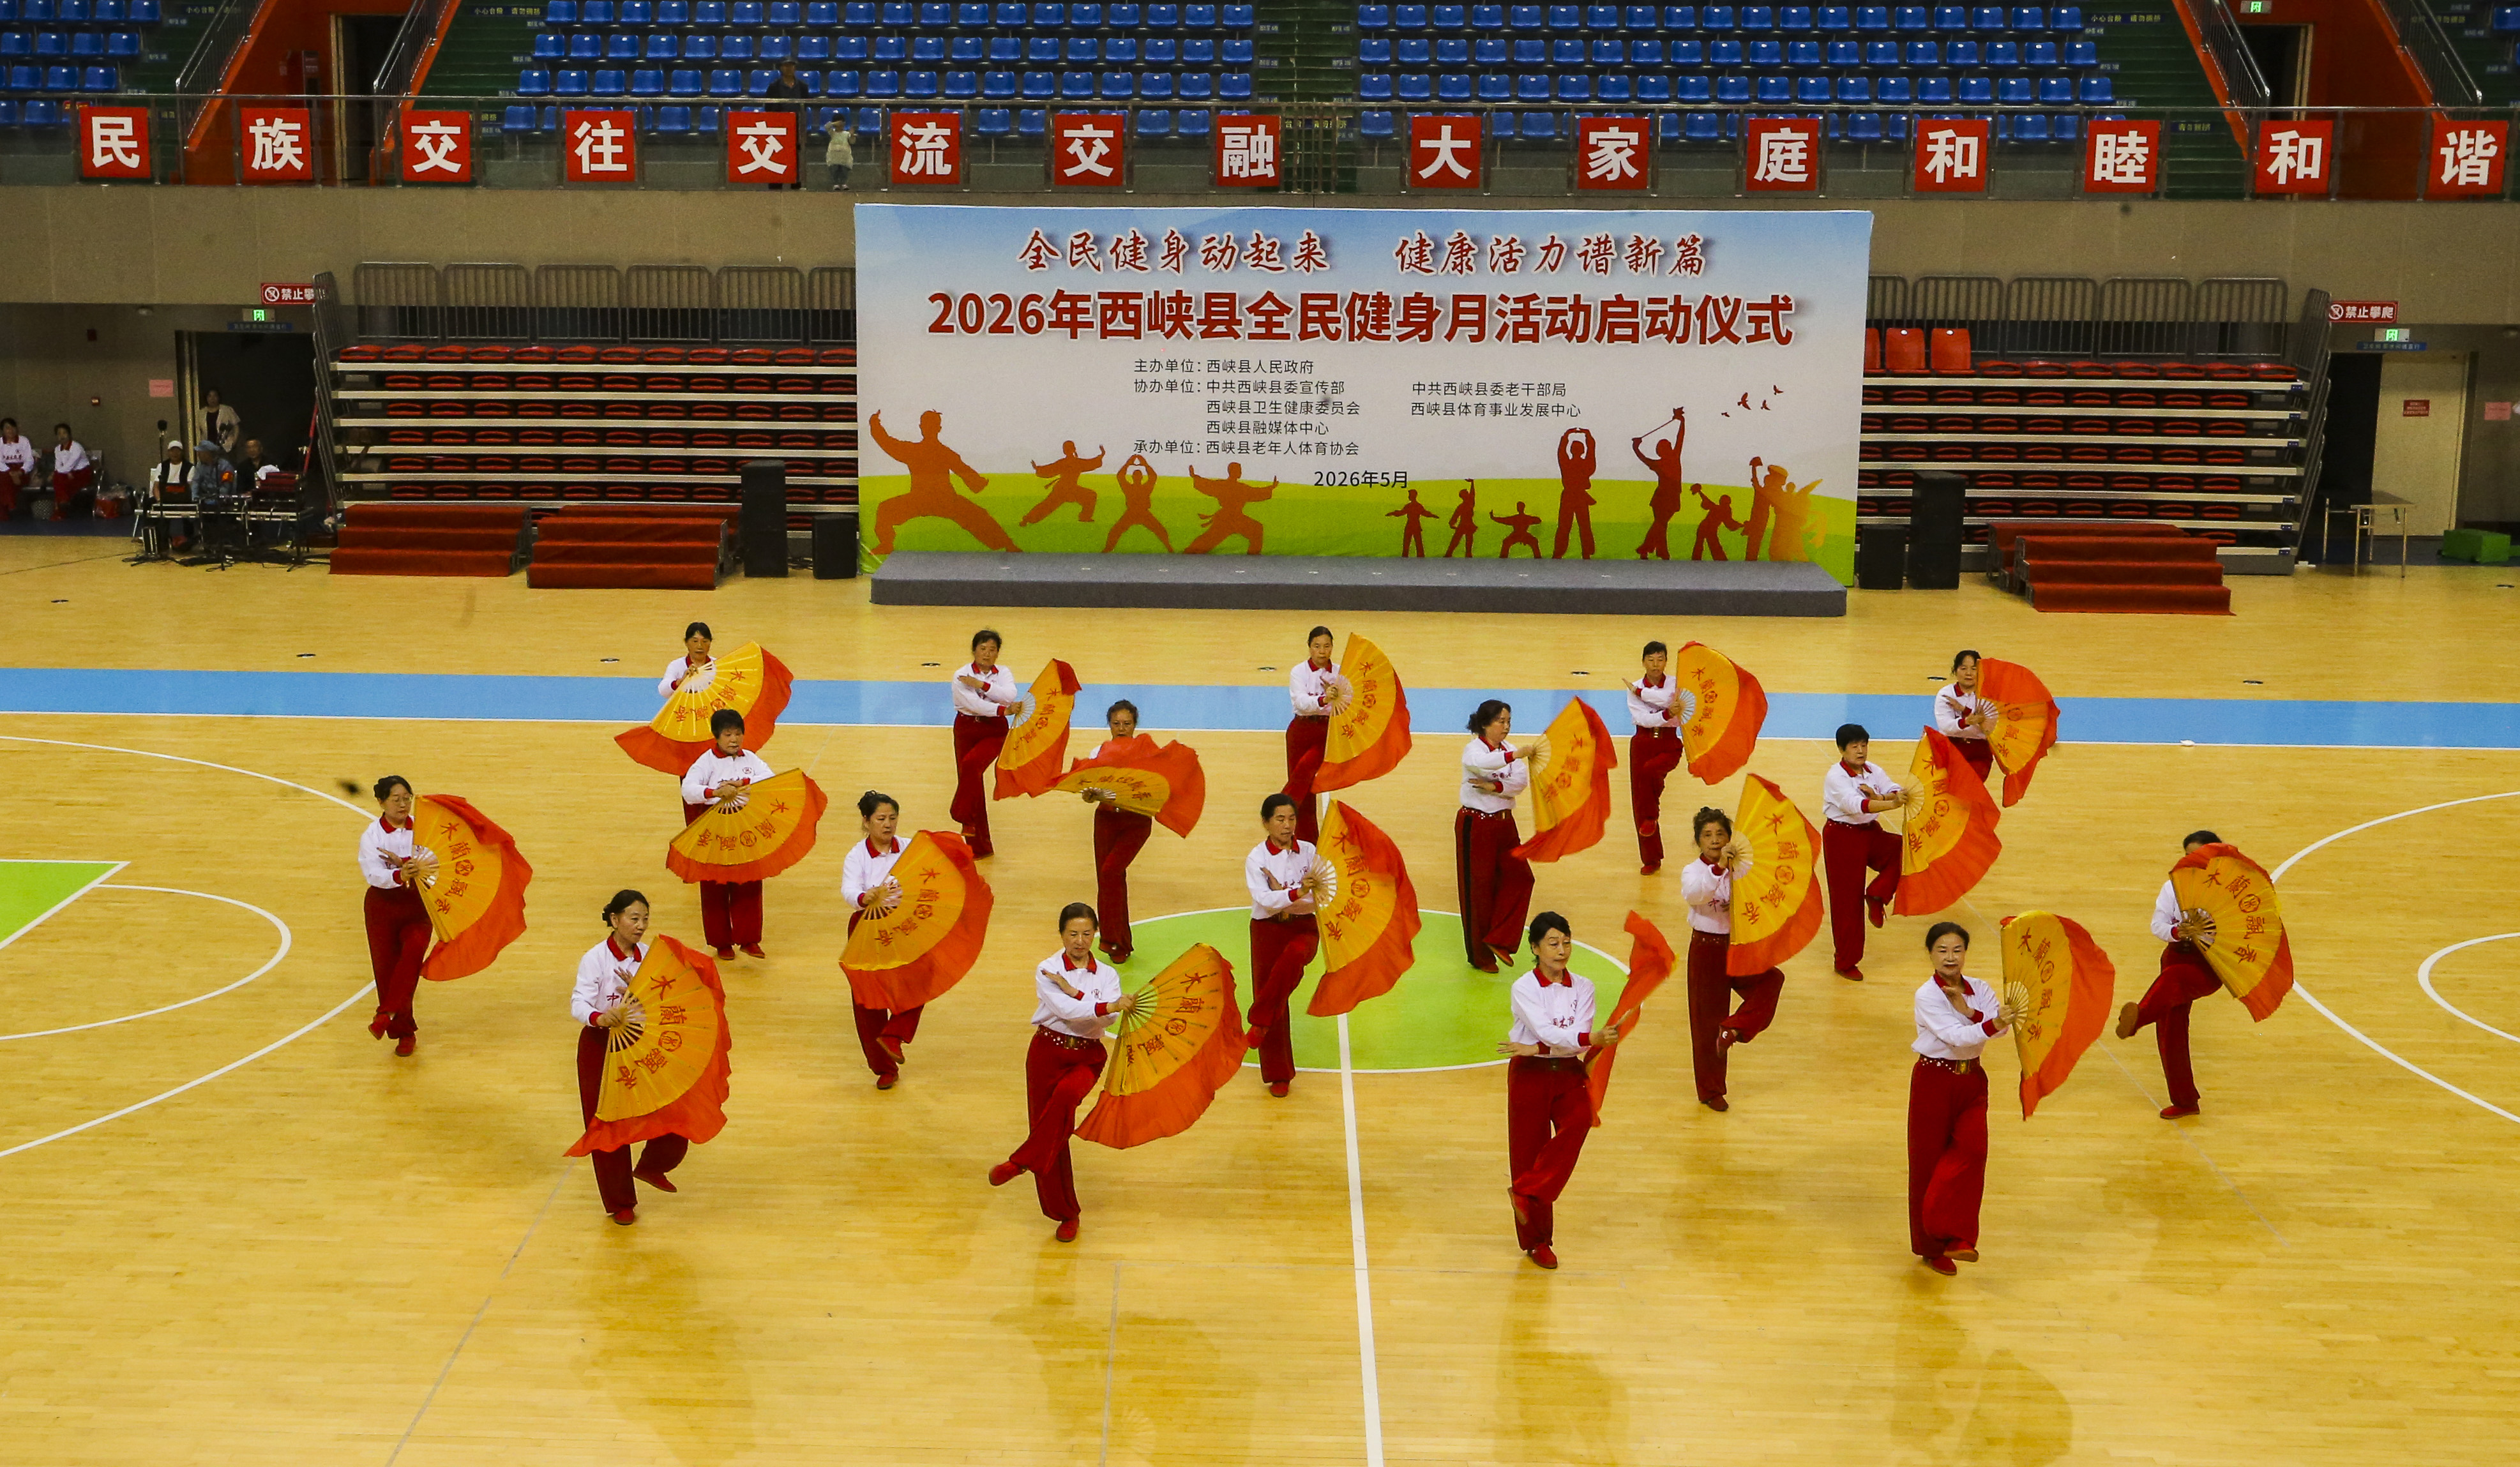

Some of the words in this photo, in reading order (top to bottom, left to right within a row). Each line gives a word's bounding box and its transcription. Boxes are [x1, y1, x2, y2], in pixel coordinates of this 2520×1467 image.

[93, 117, 139, 169] 民
[249, 118, 303, 170] 族
[411, 120, 462, 173] 交
[574, 120, 627, 174] 往
[737, 121, 787, 174] 交
[899, 122, 952, 175] 流
[1064, 124, 1113, 177] 交
[1221, 124, 1275, 178] 融
[1419, 125, 1472, 179] 大
[1587, 126, 1639, 181] 家
[1754, 128, 1809, 182] 庭
[1924, 129, 1979, 183] 和
[2094, 130, 2149, 183] 睦
[2267, 130, 2322, 184] 和
[2440, 130, 2498, 185] 谐
[1020, 230, 1329, 273] 全民健身动起来
[1395, 230, 1706, 275] 健康活力谱新篇
[281, 288, 315, 301] 禁止攀
[929, 289, 1793, 345] 2026年西峡县全民健身月活动启动仪式
[2345, 306, 2394, 319] 禁止攀爬
[1412, 381, 1566, 397] 中共西峡县委老干部局
[1207, 400, 1360, 415] 西峡县卫生健康委员会
[1411, 402, 1581, 417] 西峡县体育事业发展中心
[1207, 420, 1329, 435] 西峡县融媒体中心
[1314, 470, 1407, 488] 2026年5月
